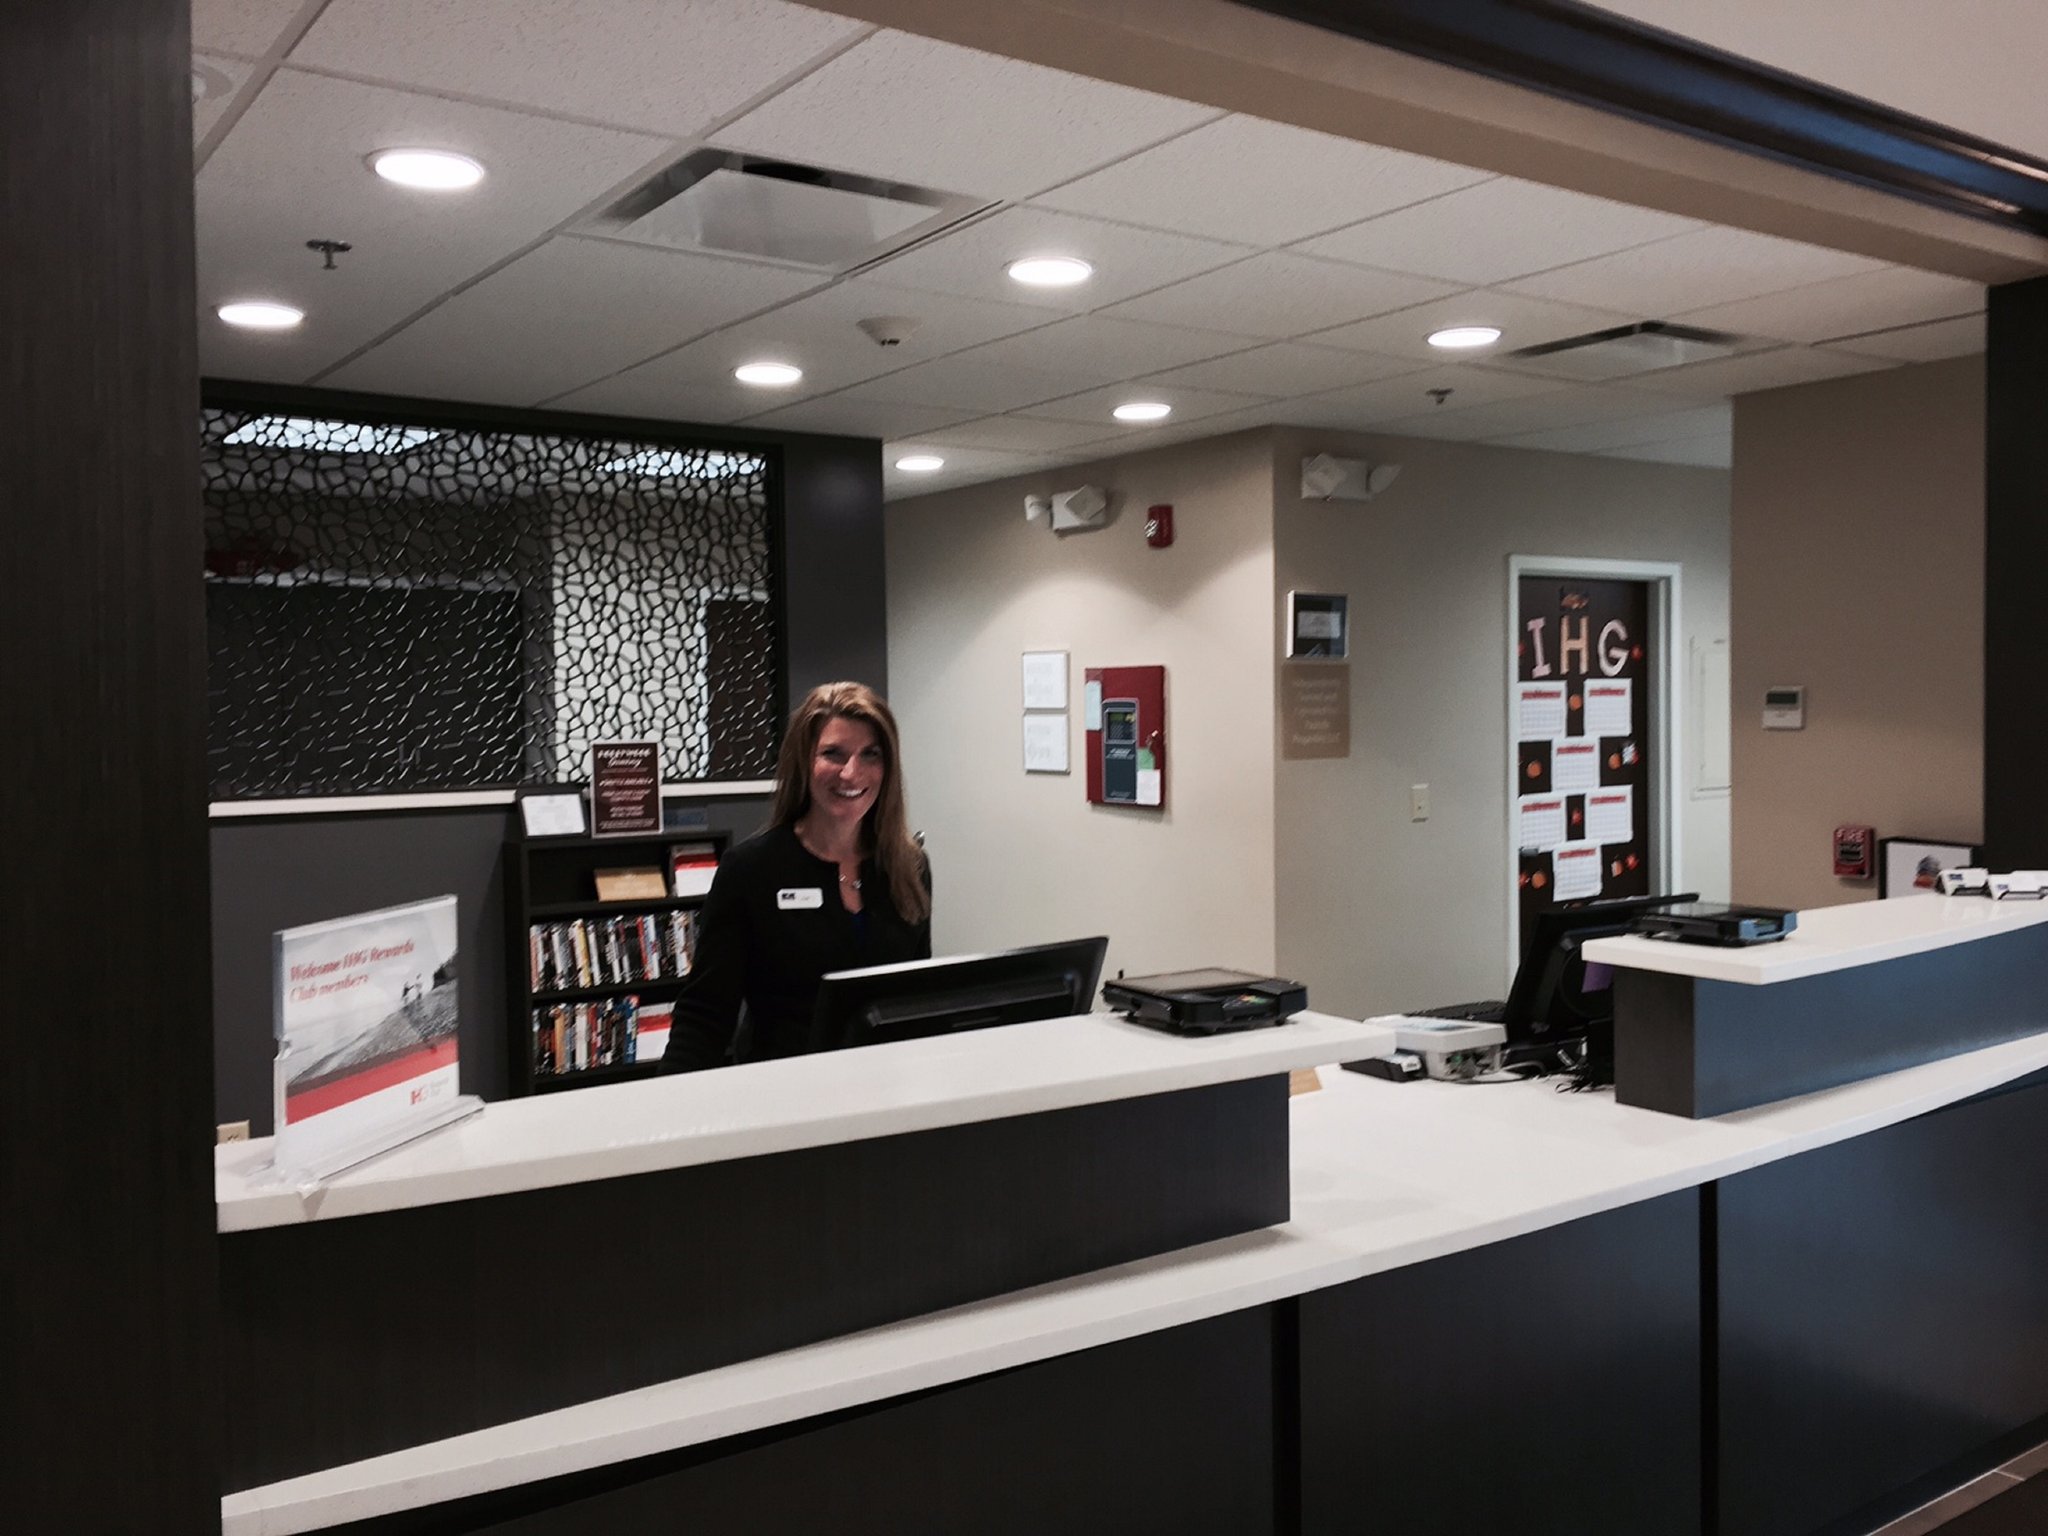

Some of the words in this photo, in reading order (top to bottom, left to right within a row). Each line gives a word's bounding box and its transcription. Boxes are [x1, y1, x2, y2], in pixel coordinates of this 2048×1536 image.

[1527, 615, 1629, 678] IHG
[1836, 829, 1865, 842] FIRE
[290, 961, 341, 981] Welcome
[370, 939, 415, 961] Rewards
[290, 984, 317, 1001] Club
[319, 974, 368, 994] members
